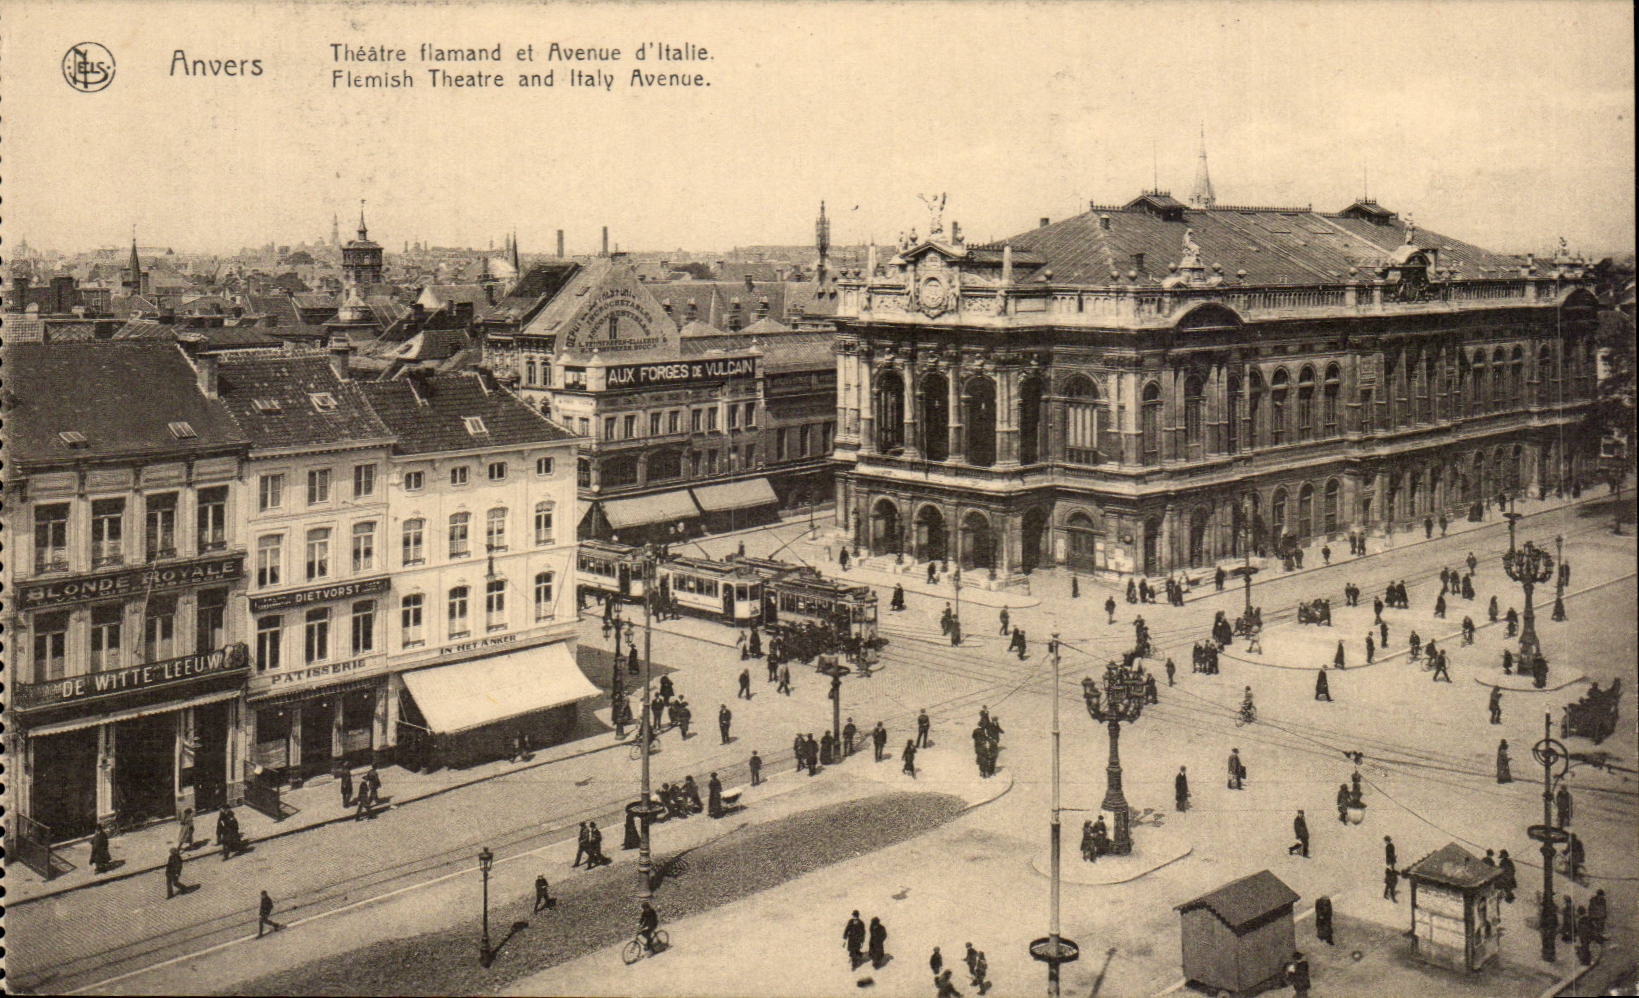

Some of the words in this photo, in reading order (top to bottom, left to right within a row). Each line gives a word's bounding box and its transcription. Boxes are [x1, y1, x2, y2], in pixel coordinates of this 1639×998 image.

[608, 367, 635, 385] AUX
[640, 364, 689, 382] FORGES
[692, 365, 703, 377] DE
[705, 359, 753, 376] VULCAIN
[26, 575, 130, 602] BLONDE
[141, 561, 236, 584] ROYALE
[295, 584, 361, 603] DIETVORST
[481, 635, 516, 647] ANKER
[62, 679, 85, 698] DE
[95, 666, 153, 692] WITTE
[164, 654, 223, 680] LEEUW
[271, 659, 366, 685] PATISSERIE
